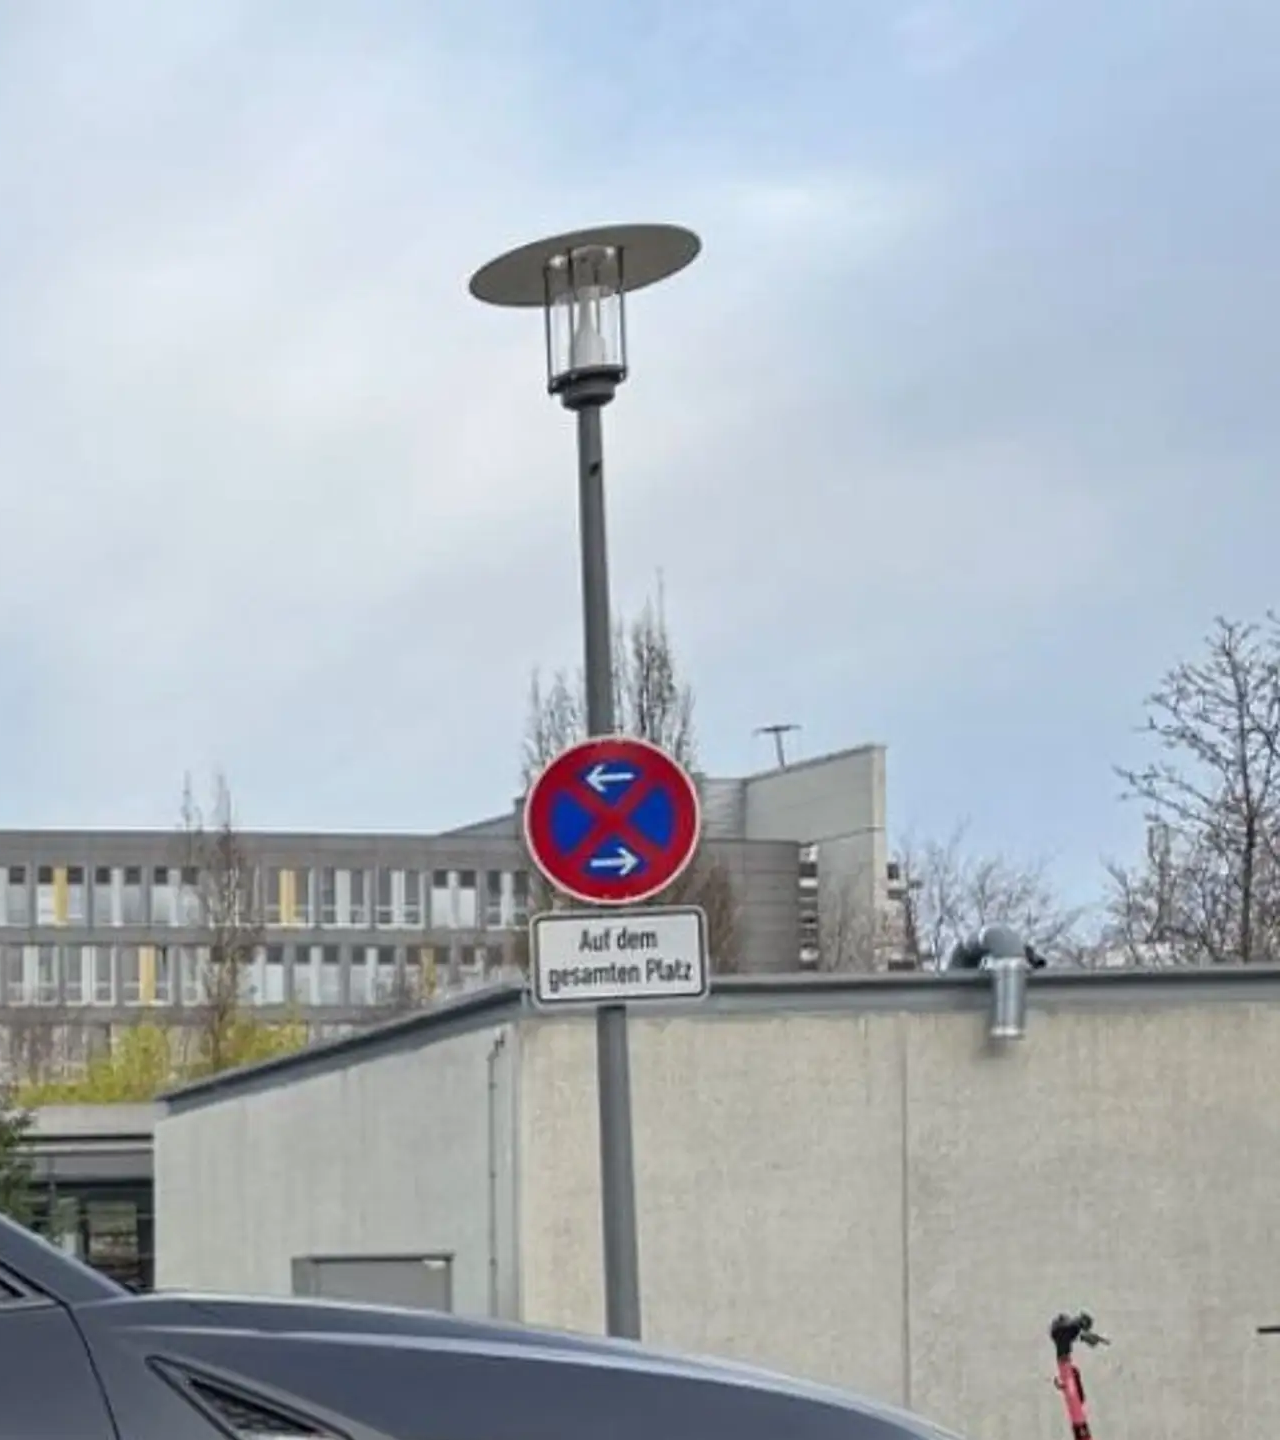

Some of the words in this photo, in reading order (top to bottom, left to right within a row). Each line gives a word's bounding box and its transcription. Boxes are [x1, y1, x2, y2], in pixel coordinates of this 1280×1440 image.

[578, 928, 611, 952] Auf
[616, 927, 658, 951] dem
[548, 962, 640, 993] gesamten
[645, 958, 693, 984] Platz
